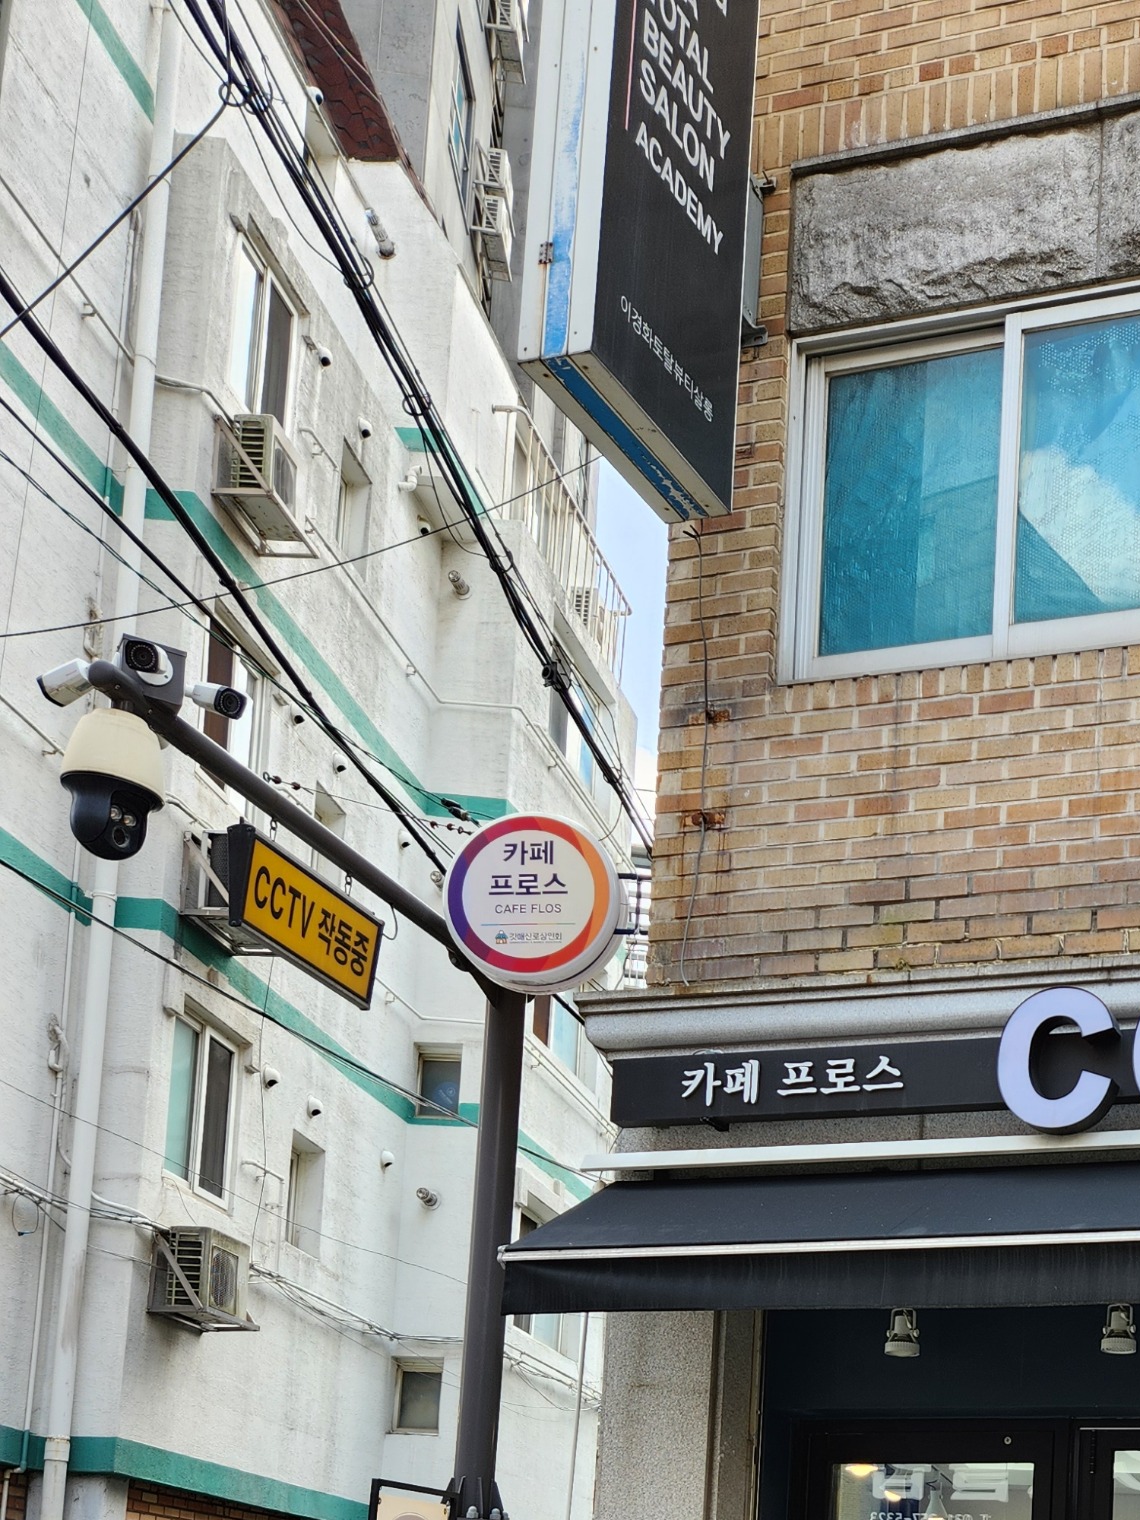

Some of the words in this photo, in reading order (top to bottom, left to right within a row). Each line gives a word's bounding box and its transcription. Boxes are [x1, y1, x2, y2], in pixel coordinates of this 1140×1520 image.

[643, 8, 731, 160] BEAUTY
[648, 0, 714, 94] OTAL
[640, 59, 715, 192] SALON
[635, 121, 724, 255] ACADEMY
[489, 873, 569, 897] 프로스
[502, 840, 554, 867] 카페
[254, 866, 315, 939] CCTV
[318, 908, 370, 977] 작동중
[495, 904, 527, 914] CAFE
[531, 903, 562, 913] FLOS
[681, 1059, 760, 1107] 카페
[777, 1055, 905, 1097] 프로스
